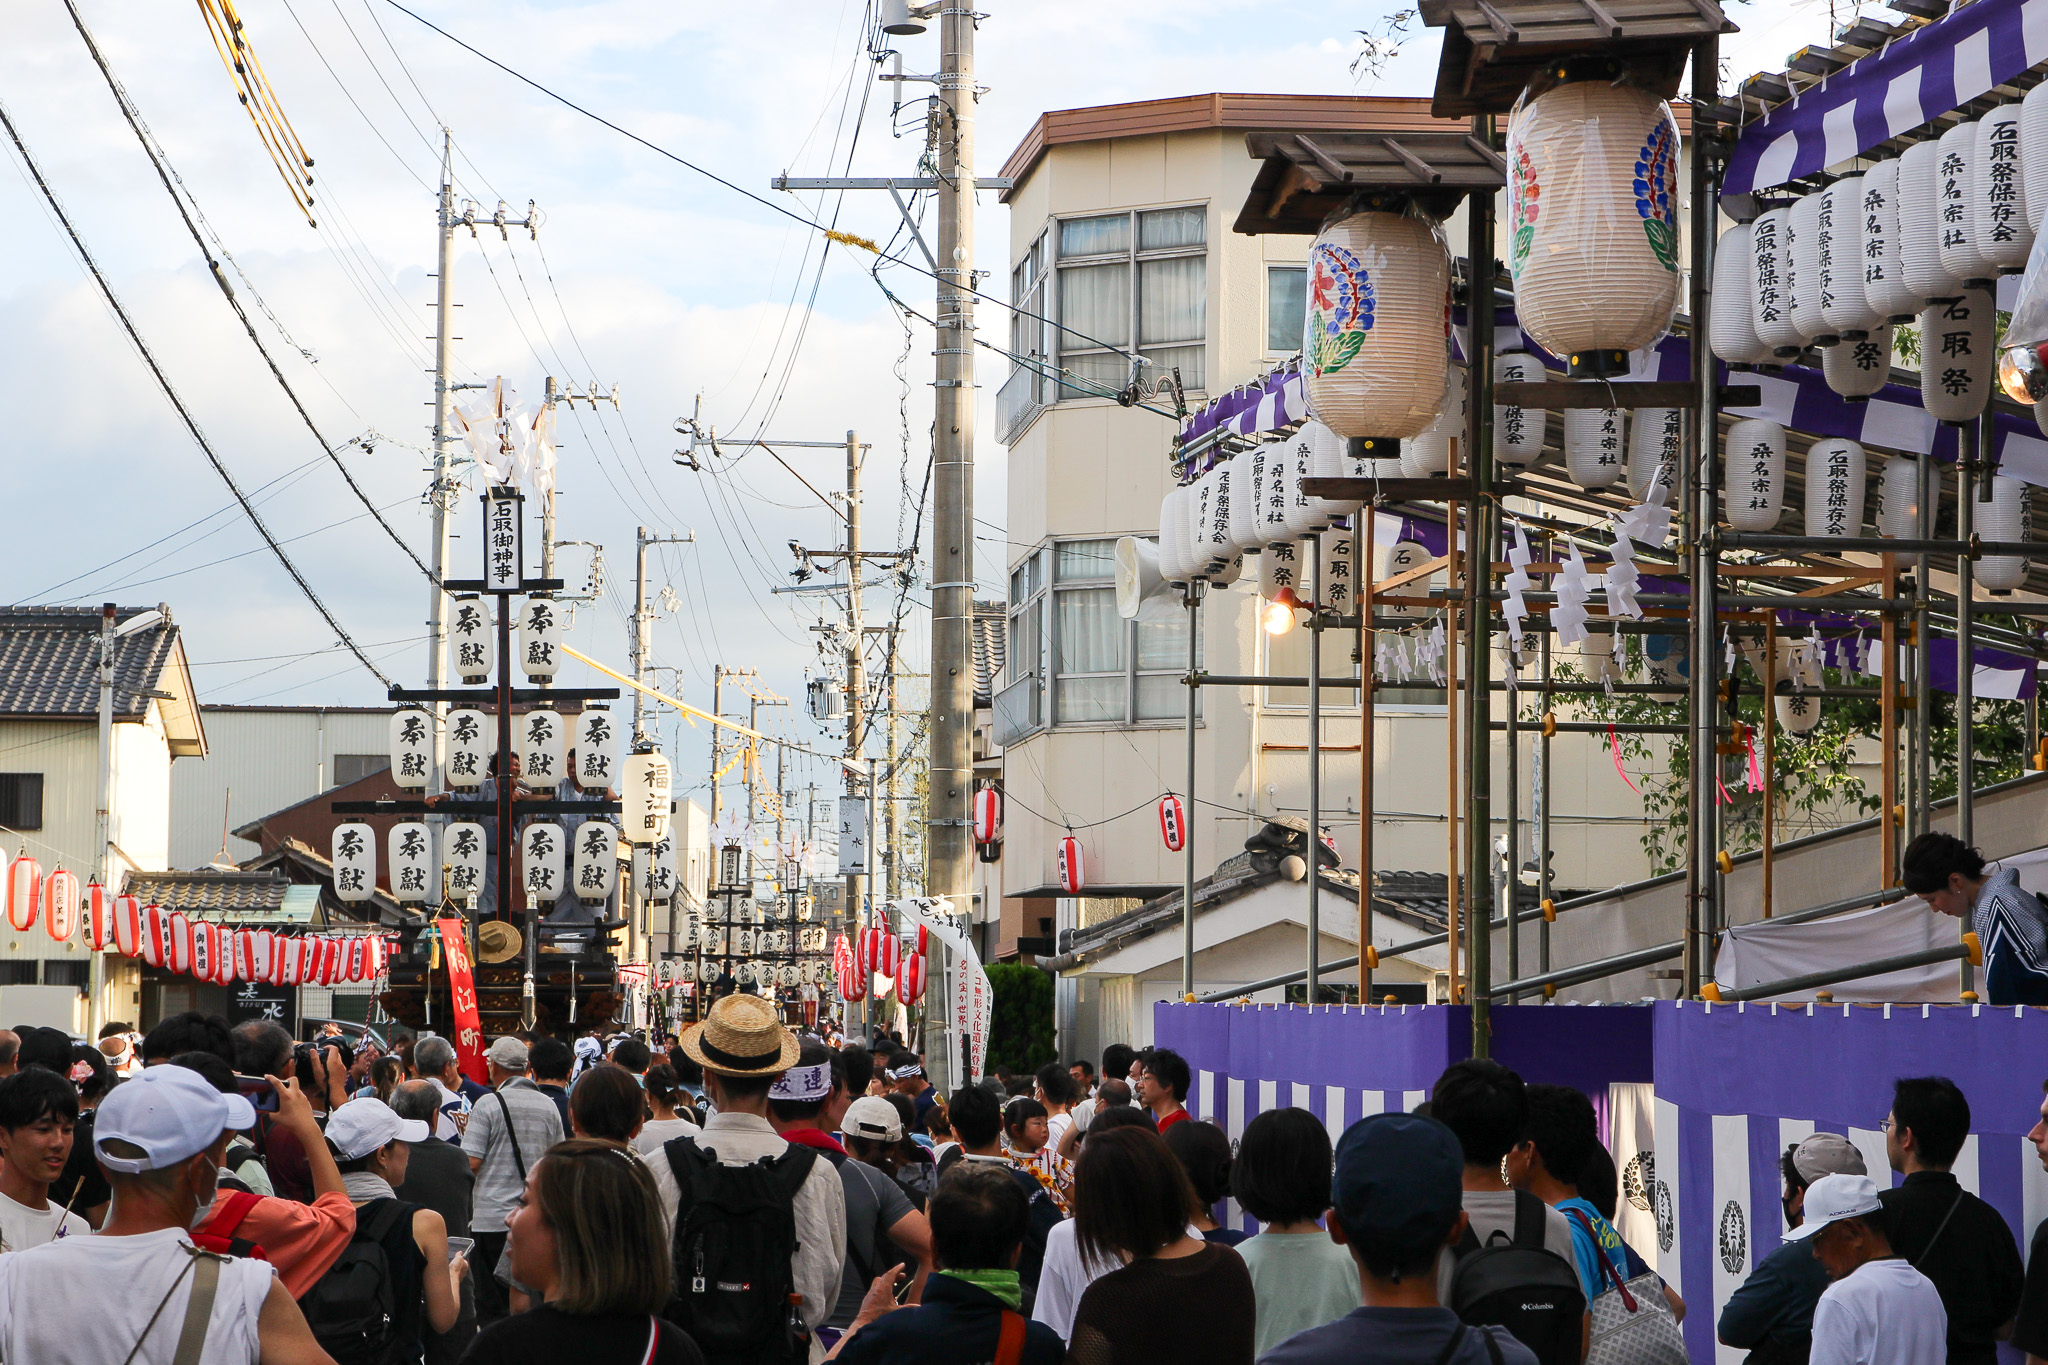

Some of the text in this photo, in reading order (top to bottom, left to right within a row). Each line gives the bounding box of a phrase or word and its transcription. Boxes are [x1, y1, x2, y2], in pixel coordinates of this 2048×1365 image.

[1987, 121, 2018, 242] 石取祭保存会
[1755, 218, 1781, 322] 石取祭保存会
[1940, 295, 1973, 397] 石取祭
[1825, 450, 1848, 535] 石取祭保存会
[491, 500, 515, 584] 石取御神事
[1328, 539, 1351, 601] 石取祭
[643, 761, 673, 836] 福江町
